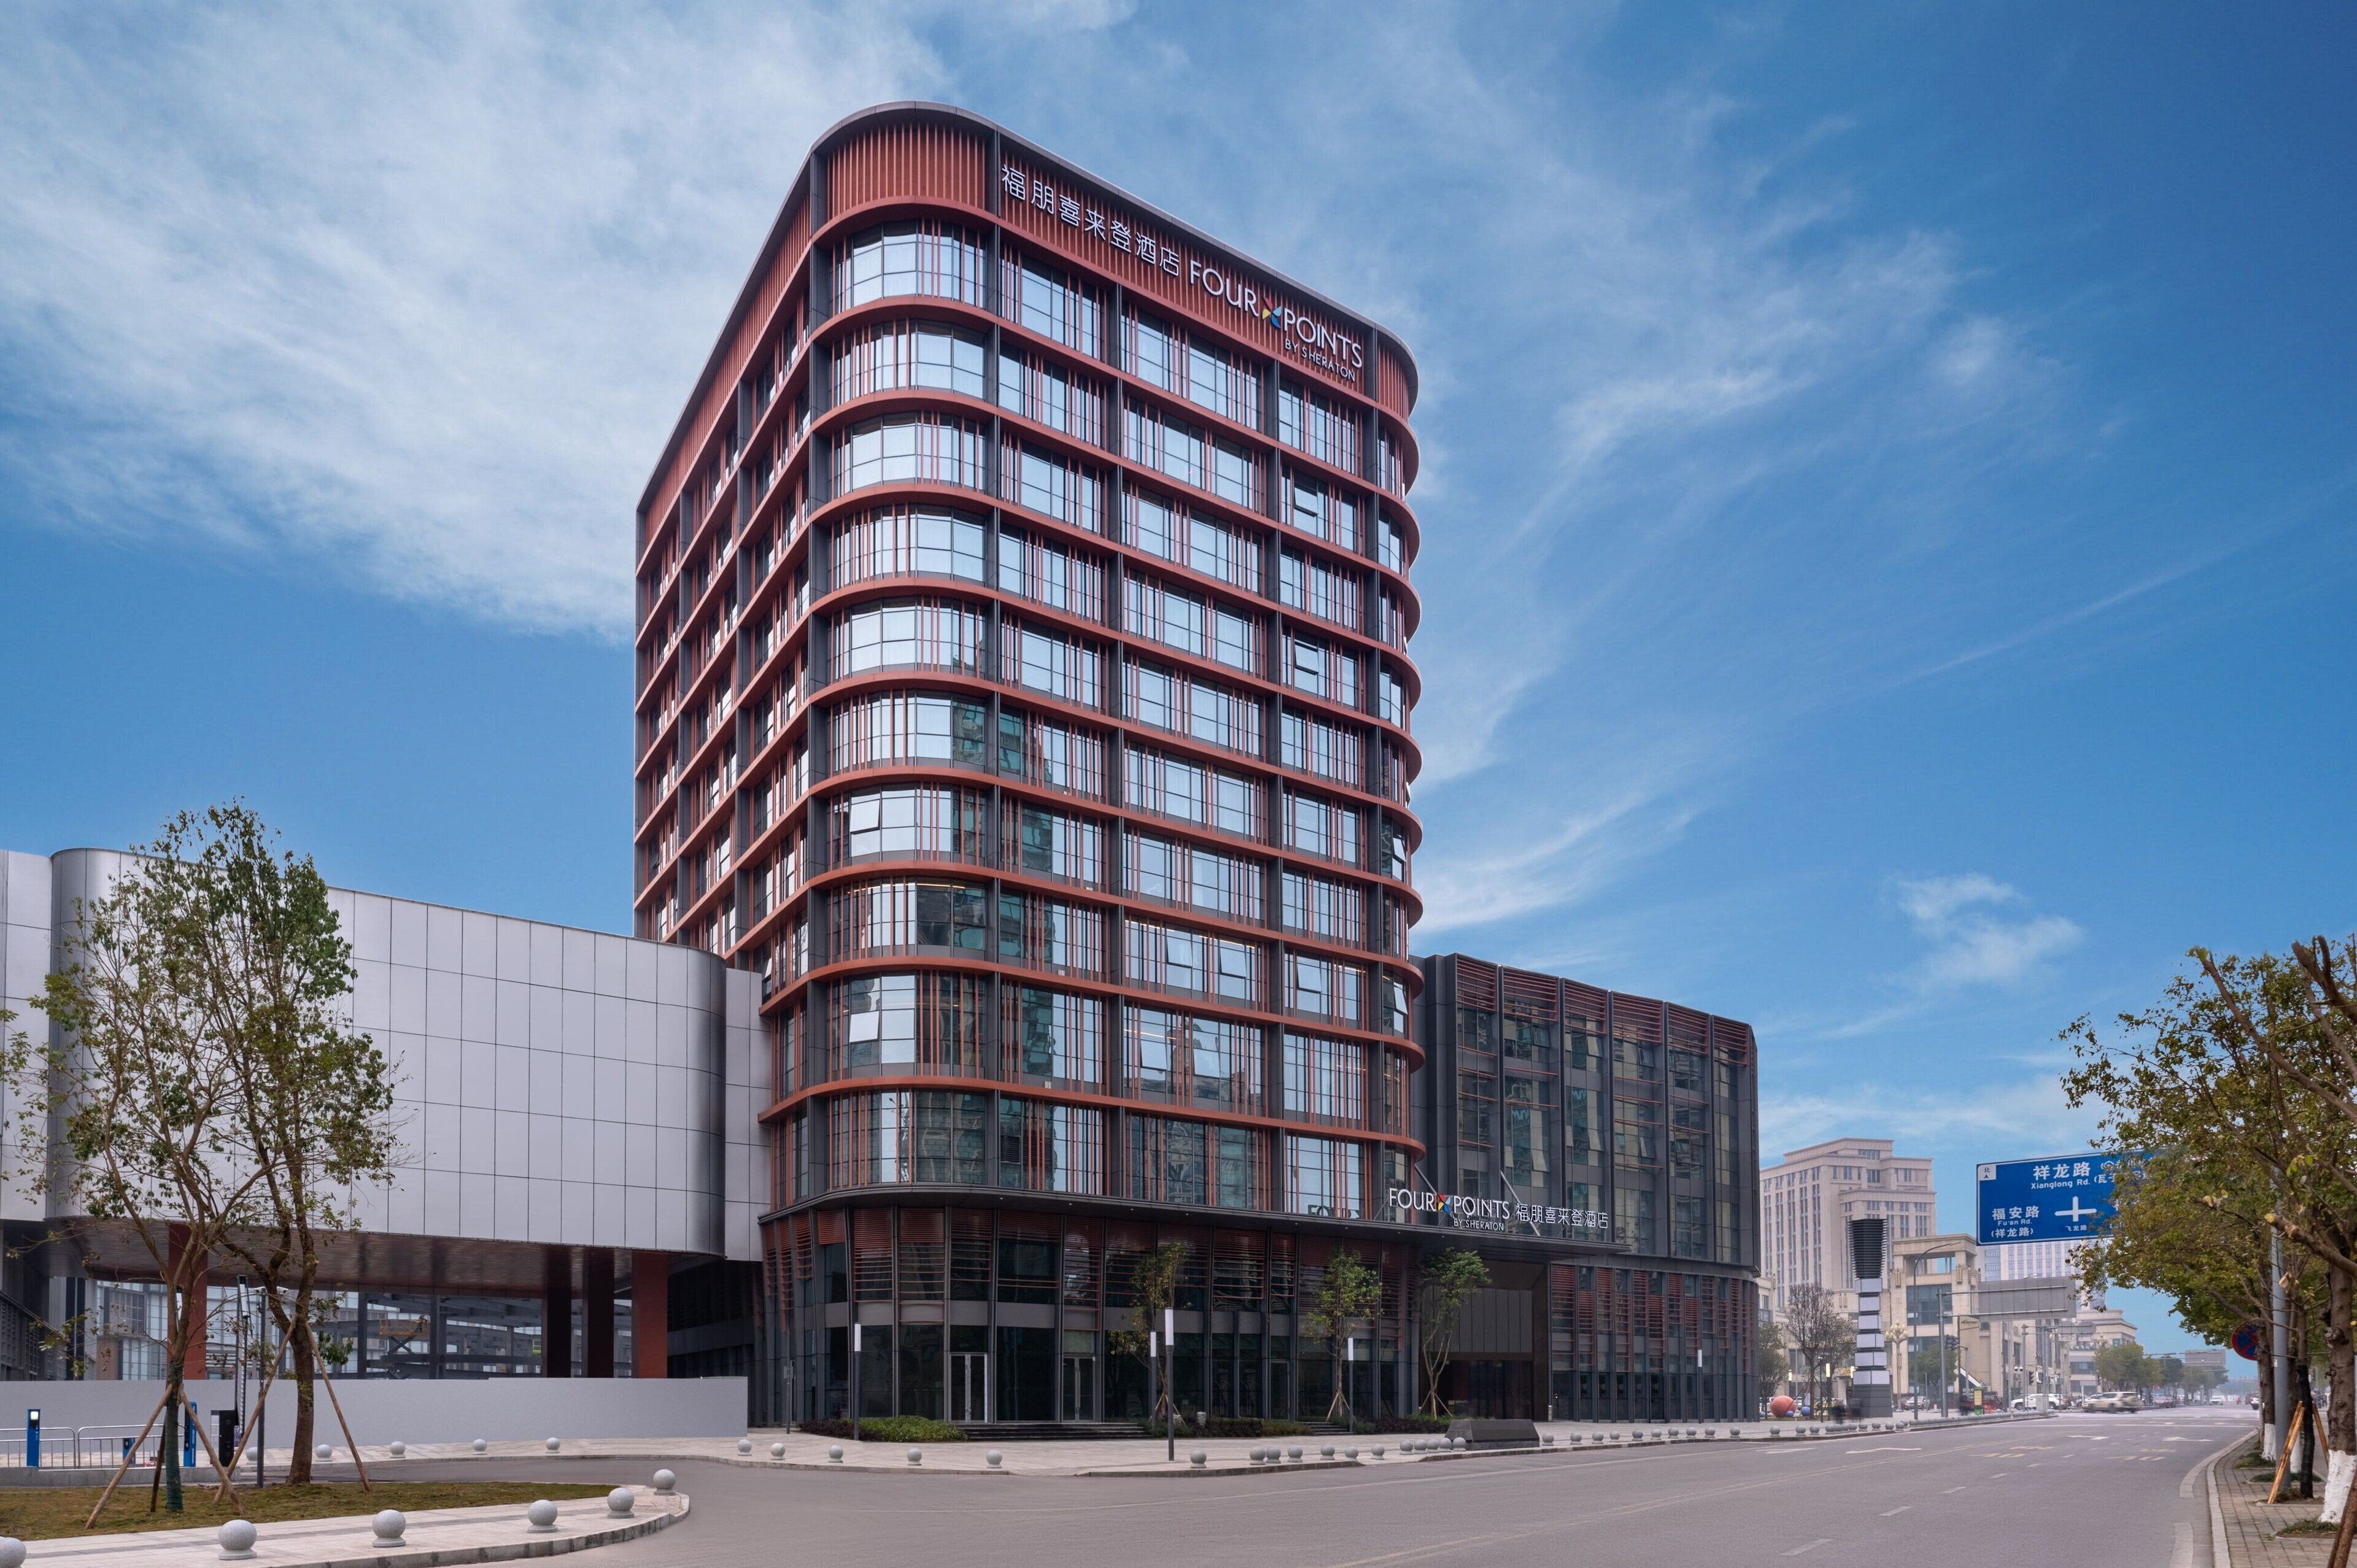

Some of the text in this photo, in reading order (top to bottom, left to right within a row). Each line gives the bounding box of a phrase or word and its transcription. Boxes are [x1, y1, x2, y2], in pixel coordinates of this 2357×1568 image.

[1002, 164, 1180, 276] 福朋喜来登酒店
[1190, 259, 1362, 368] FOUR POINTS
[1285, 338, 1355, 382] BY SHERATON
[2033, 1162, 2091, 1180] 祥龙路
[2031, 1181, 2073, 1189] Xianglong
[1389, 1188, 1436, 1211] FOUR
[1453, 1195, 1510, 1219] POINTS
[1992, 1205, 2040, 1220] 福安路
[1466, 1219, 1504, 1231] SHERATON
[1515, 1203, 1608, 1229] 福朋喜来登酒店
[1991, 1227, 2034, 1238] (祥龙路)
